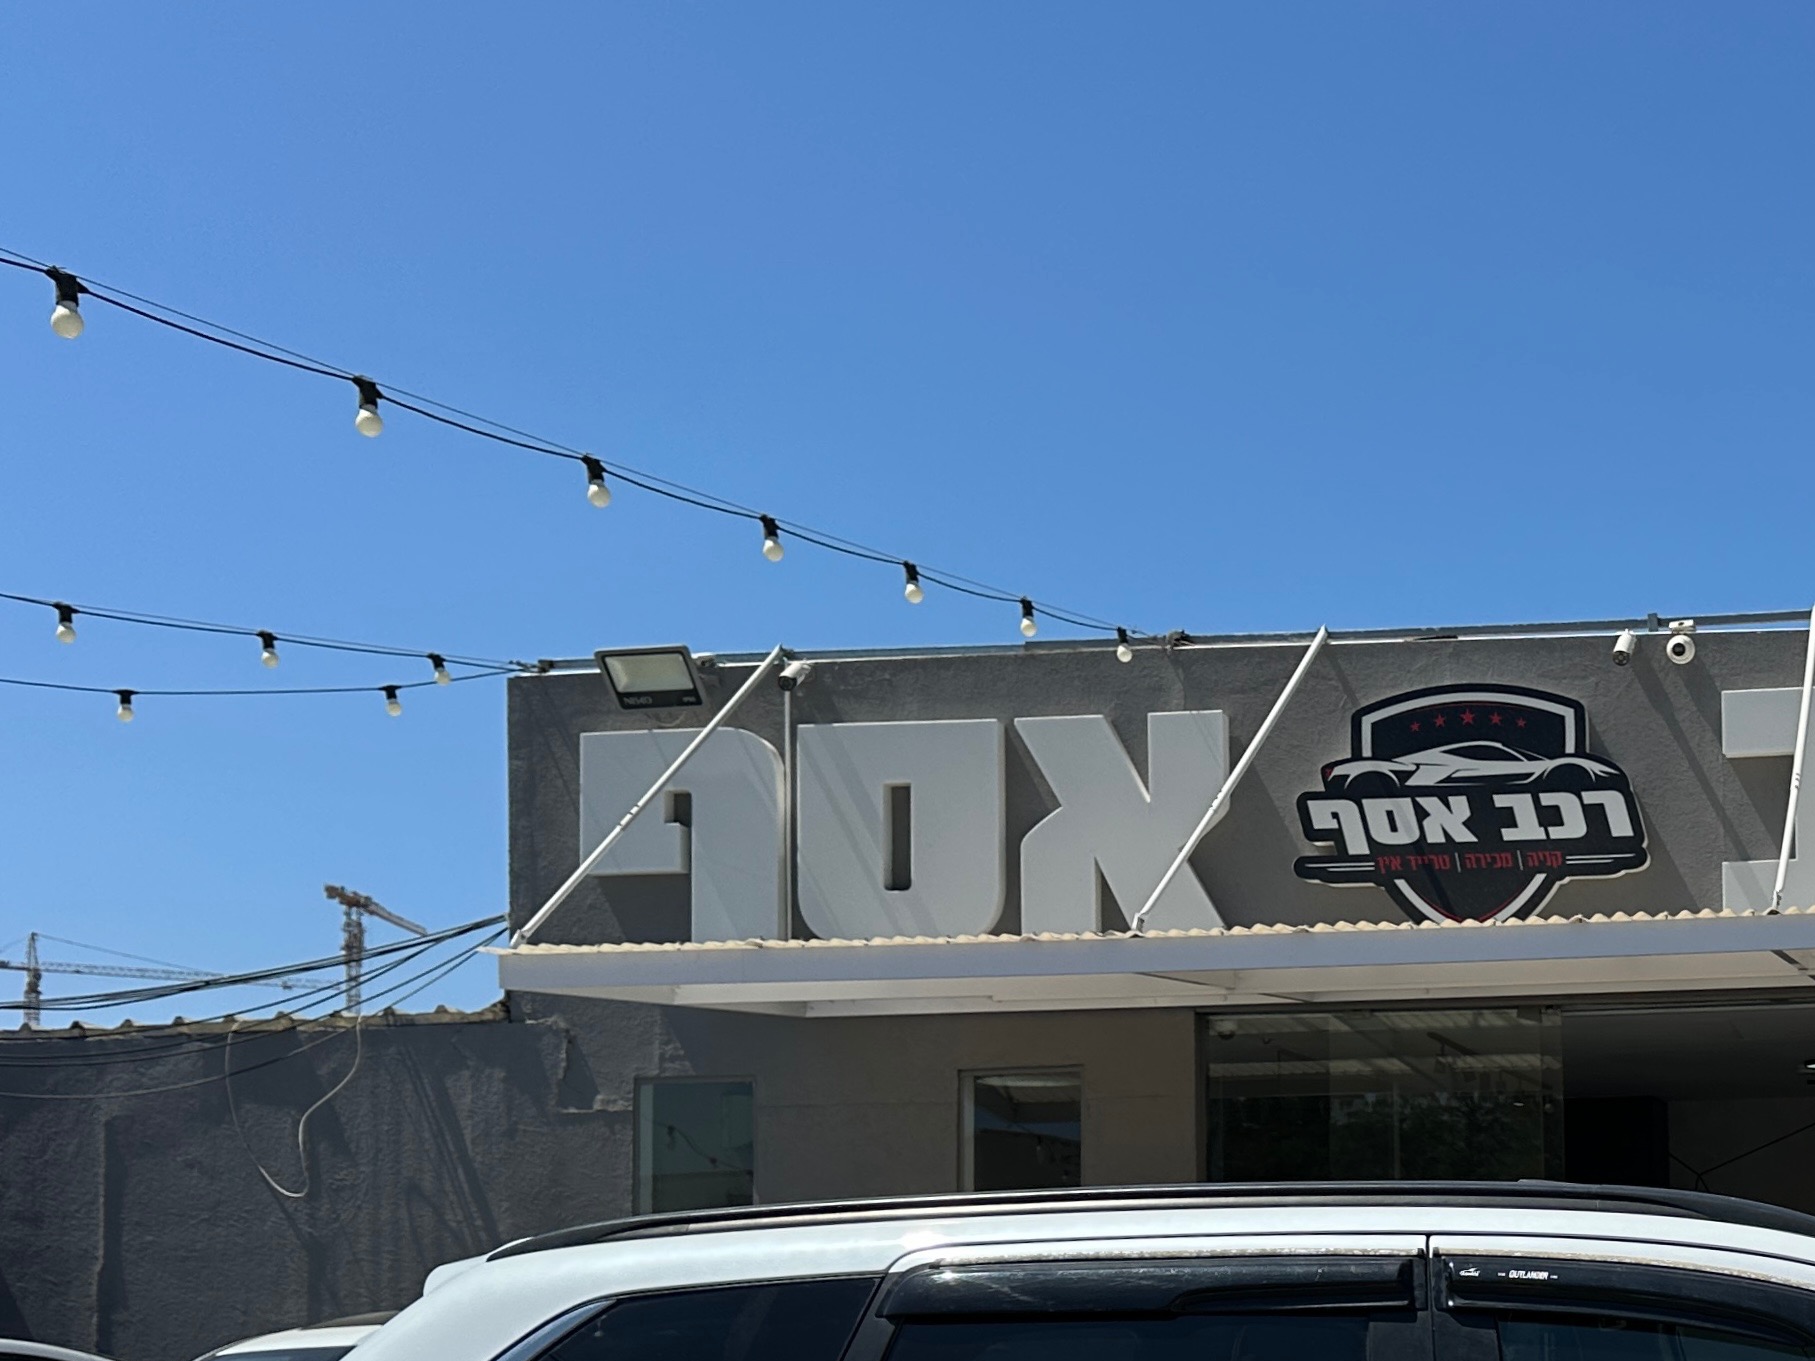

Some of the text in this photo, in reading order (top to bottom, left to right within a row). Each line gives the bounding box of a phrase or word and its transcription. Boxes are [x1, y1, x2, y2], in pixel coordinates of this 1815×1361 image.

[579, 709, 1232, 942] אסף
[1306, 789, 1635, 856] רכב אסף
[1376, 850, 1563, 874] קניה מכירה טרייד אין
[1508, 1269, 1549, 1280] OUTLANDER
